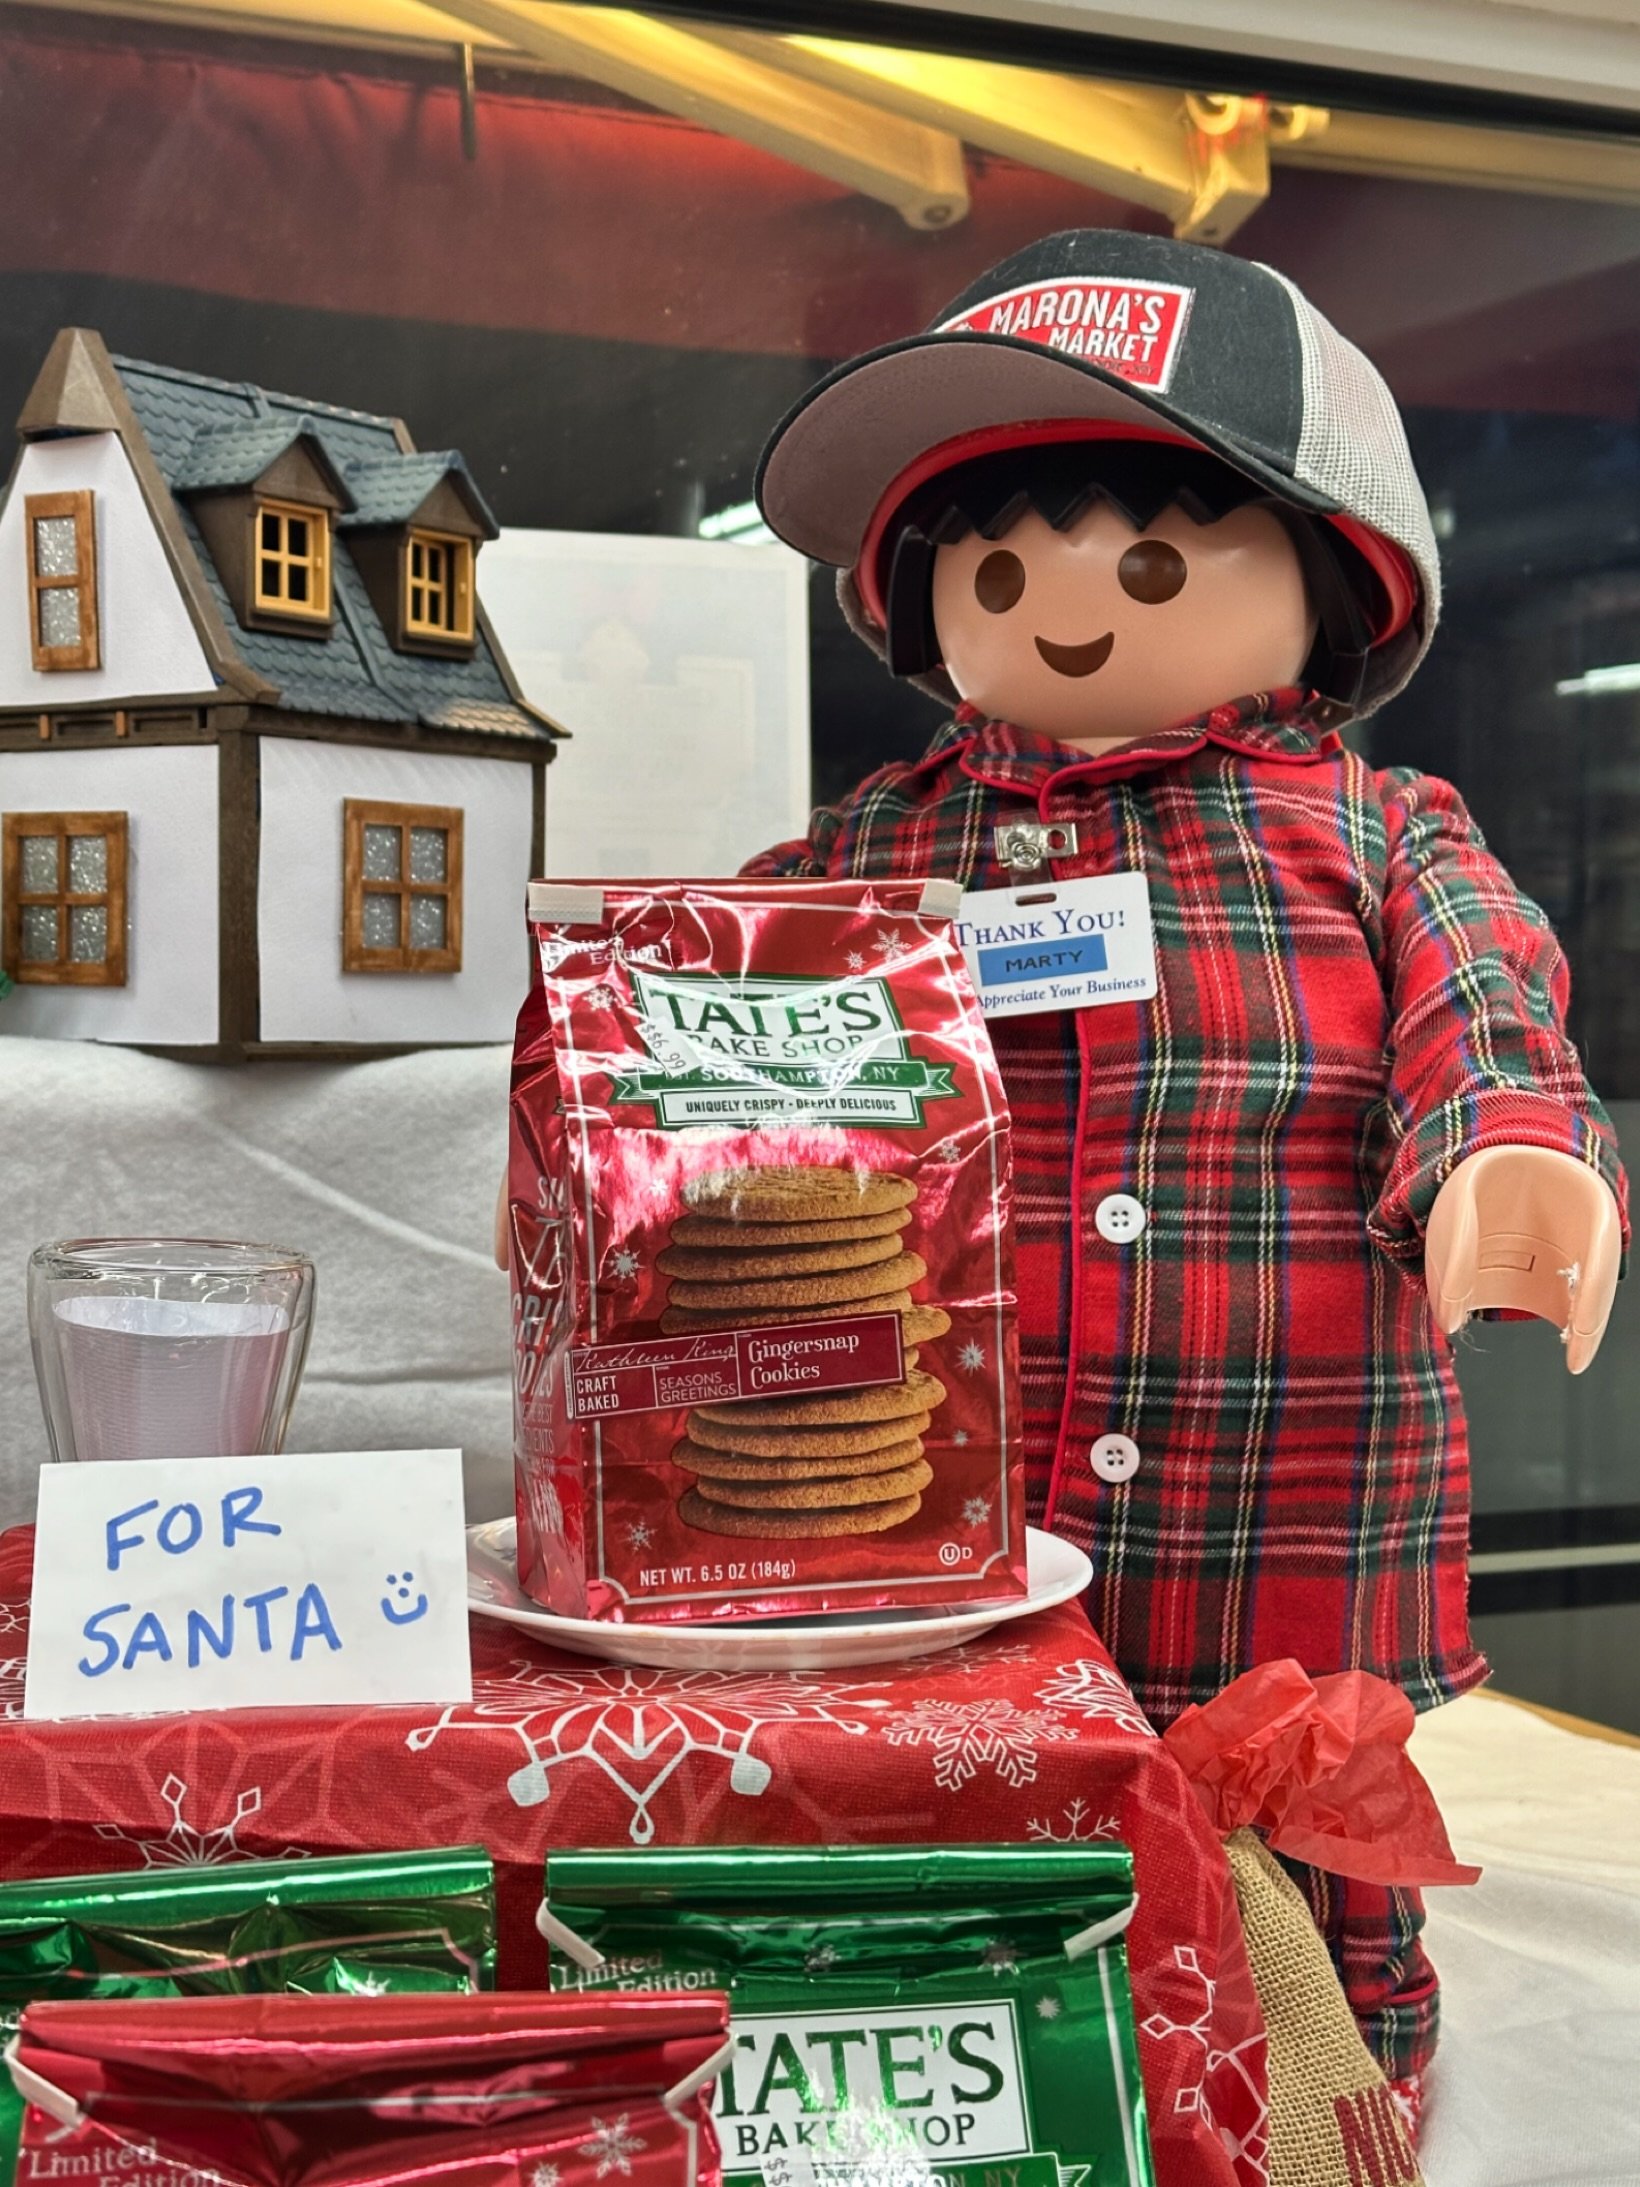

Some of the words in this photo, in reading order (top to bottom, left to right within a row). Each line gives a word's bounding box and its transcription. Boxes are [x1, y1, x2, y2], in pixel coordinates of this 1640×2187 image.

[988, 289, 1165, 334] MARONA'S
[1049, 326, 1159, 363] MARKET
[955, 921, 1046, 947] THANK
[1052, 908, 1126, 936] YOU!
[1005, 950, 1084, 973] MARTY
[977, 986, 1046, 1010] Appreciate
[1049, 984, 1082, 999] Your
[1087, 976, 1147, 994] Business
[650, 991, 882, 1038] TATE'S
[782, 1034, 863, 1059] SHOP
[872, 1065, 900, 1081] NY
[686, 1098, 740, 1113] UNIQUELY
[744, 1098, 785, 1112] CRISPY
[796, 1097, 836, 1110] DEEPLY
[839, 1097, 897, 1111] DELICIOUS
[748, 1332, 860, 1363] Gingersnap
[576, 1375, 617, 1394] CRAFT
[659, 1371, 723, 1391] SEASONS
[750, 1362, 821, 1390] Cookies
[578, 1393, 620, 1413] BAKED
[661, 1383, 737, 1403] GREETINGS
[106, 1485, 282, 1571] FOR
[640, 1567, 667, 1587] NET
[671, 1566, 696, 1584] WT.
[700, 1564, 724, 1582] 6.5
[728, 1563, 747, 1580] OZ
[751, 1559, 796, 1579] (184g)
[78, 1583, 342, 1677] SANTA
[715, 2020, 1004, 2119] TATE'S
[28, 2137, 157, 2180] Limited
